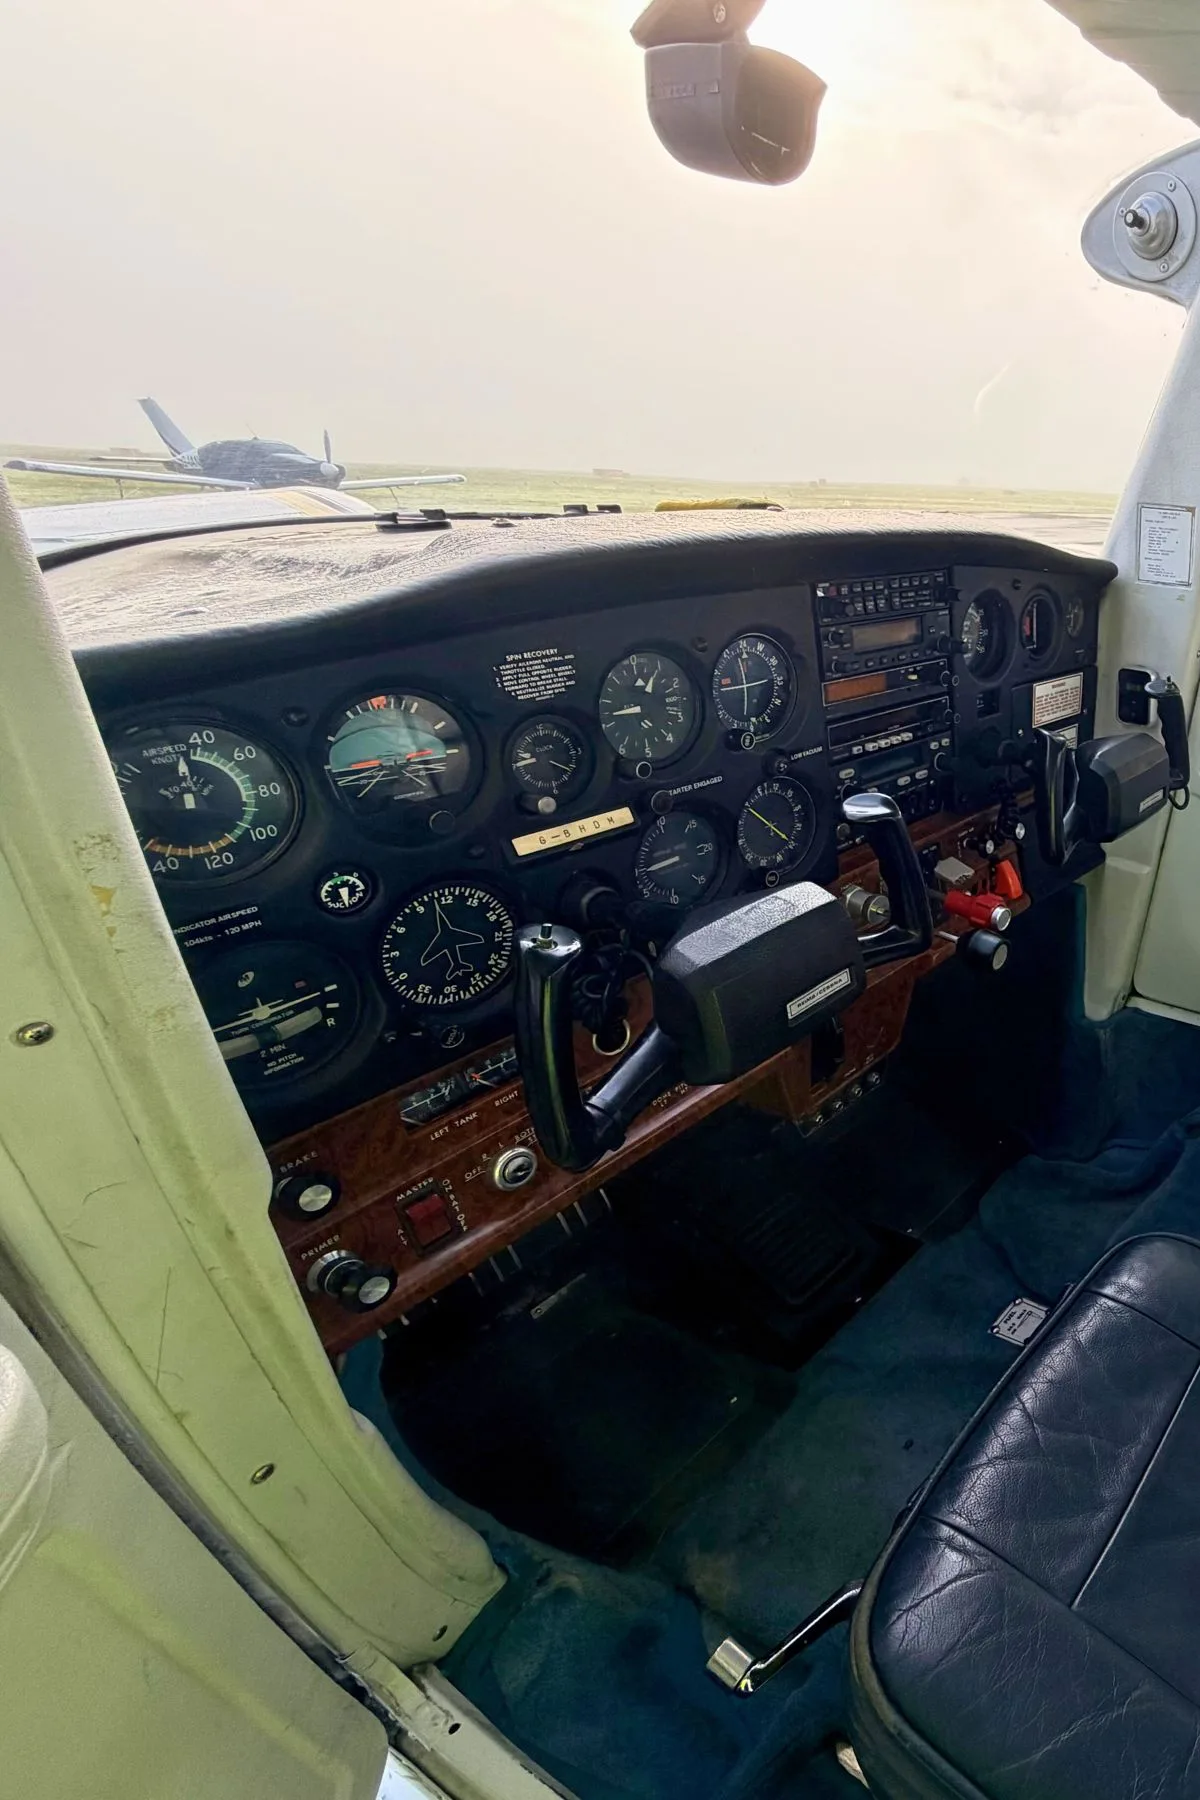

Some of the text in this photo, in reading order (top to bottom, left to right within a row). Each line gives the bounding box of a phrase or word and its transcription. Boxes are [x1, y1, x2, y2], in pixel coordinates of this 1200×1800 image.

[629, 654, 637, 665] 0
[672, 677, 680, 689] 2
[677, 711, 684, 723] 3
[188, 729, 216, 746] 40
[666, 731, 674, 743] 4
[141, 743, 187, 757] AIRSPEED
[233, 745, 257, 761] 60
[618, 744, 626, 755] 6
[644, 747, 653, 758] 5
[258, 782, 281, 798] 80
[668, 776, 723, 797] TARTER ENGAGED
[656, 816, 666, 827] 10
[249, 824, 278, 842] 100
[703, 843, 713, 853] 20
[204, 852, 234, 870] 120
[643, 888, 650, 898] 5
[327, 892, 364, 908] SUCION
[440, 896, 454, 905] 12
[466, 898, 479, 907] 15
[173, 906, 258, 934] NDICATOR AIRSPEED
[485, 910, 498, 922] 18
[224, 926, 241, 935] 120
[241, 920, 262, 931] MPH
[494, 931, 503, 942] 21
[390, 950, 400, 958] 3
[487, 953, 499, 965] 24
[398, 972, 408, 980] 0
[470, 972, 482, 985] 27
[417, 984, 432, 994] 33
[443, 984, 458, 993] 30
[326, 1017, 336, 1027] R
[260, 1049, 267, 1058] 2
[430, 1090, 519, 1141] LEFT TANK RIGHT
[280, 1150, 319, 1173] BRAKE
[301, 1234, 341, 1260] PRIMER
